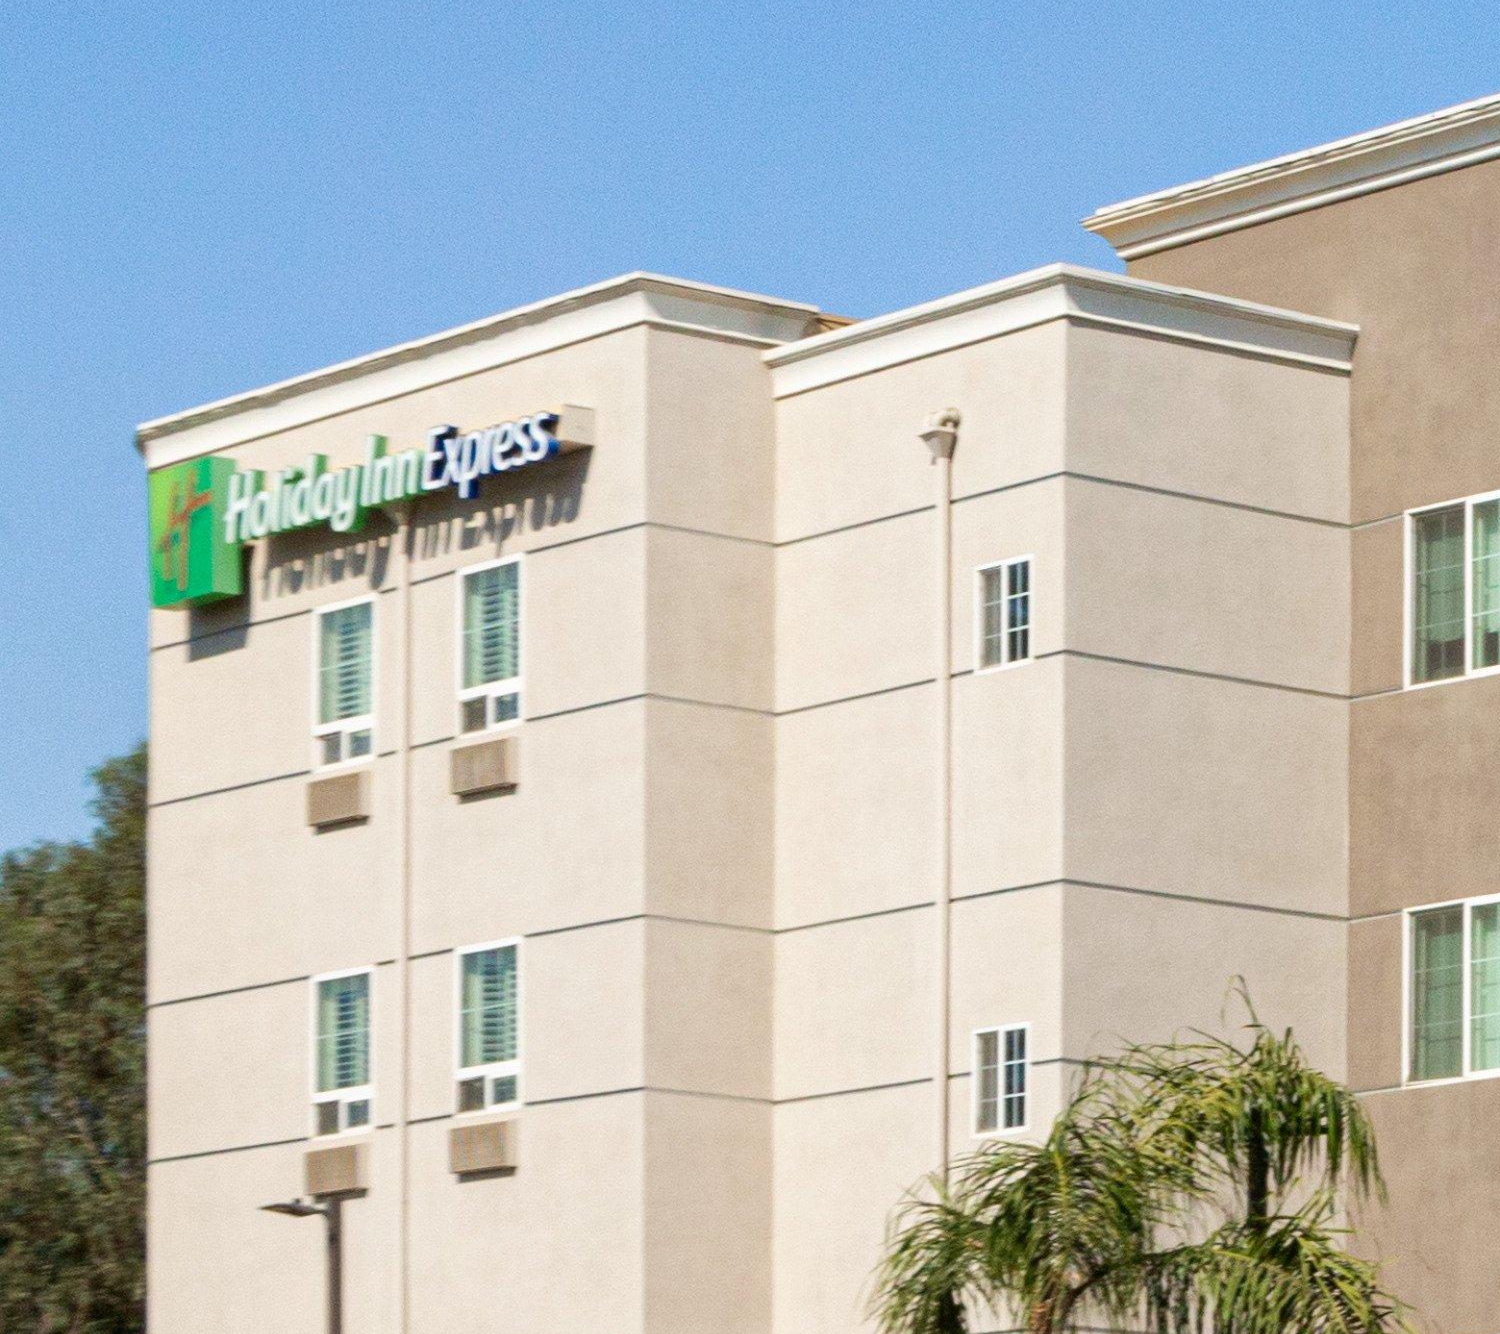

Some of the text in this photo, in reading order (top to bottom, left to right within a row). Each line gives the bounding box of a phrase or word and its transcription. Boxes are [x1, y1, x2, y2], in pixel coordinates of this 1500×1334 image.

[223, 411, 557, 543] Holiday Inn Express
